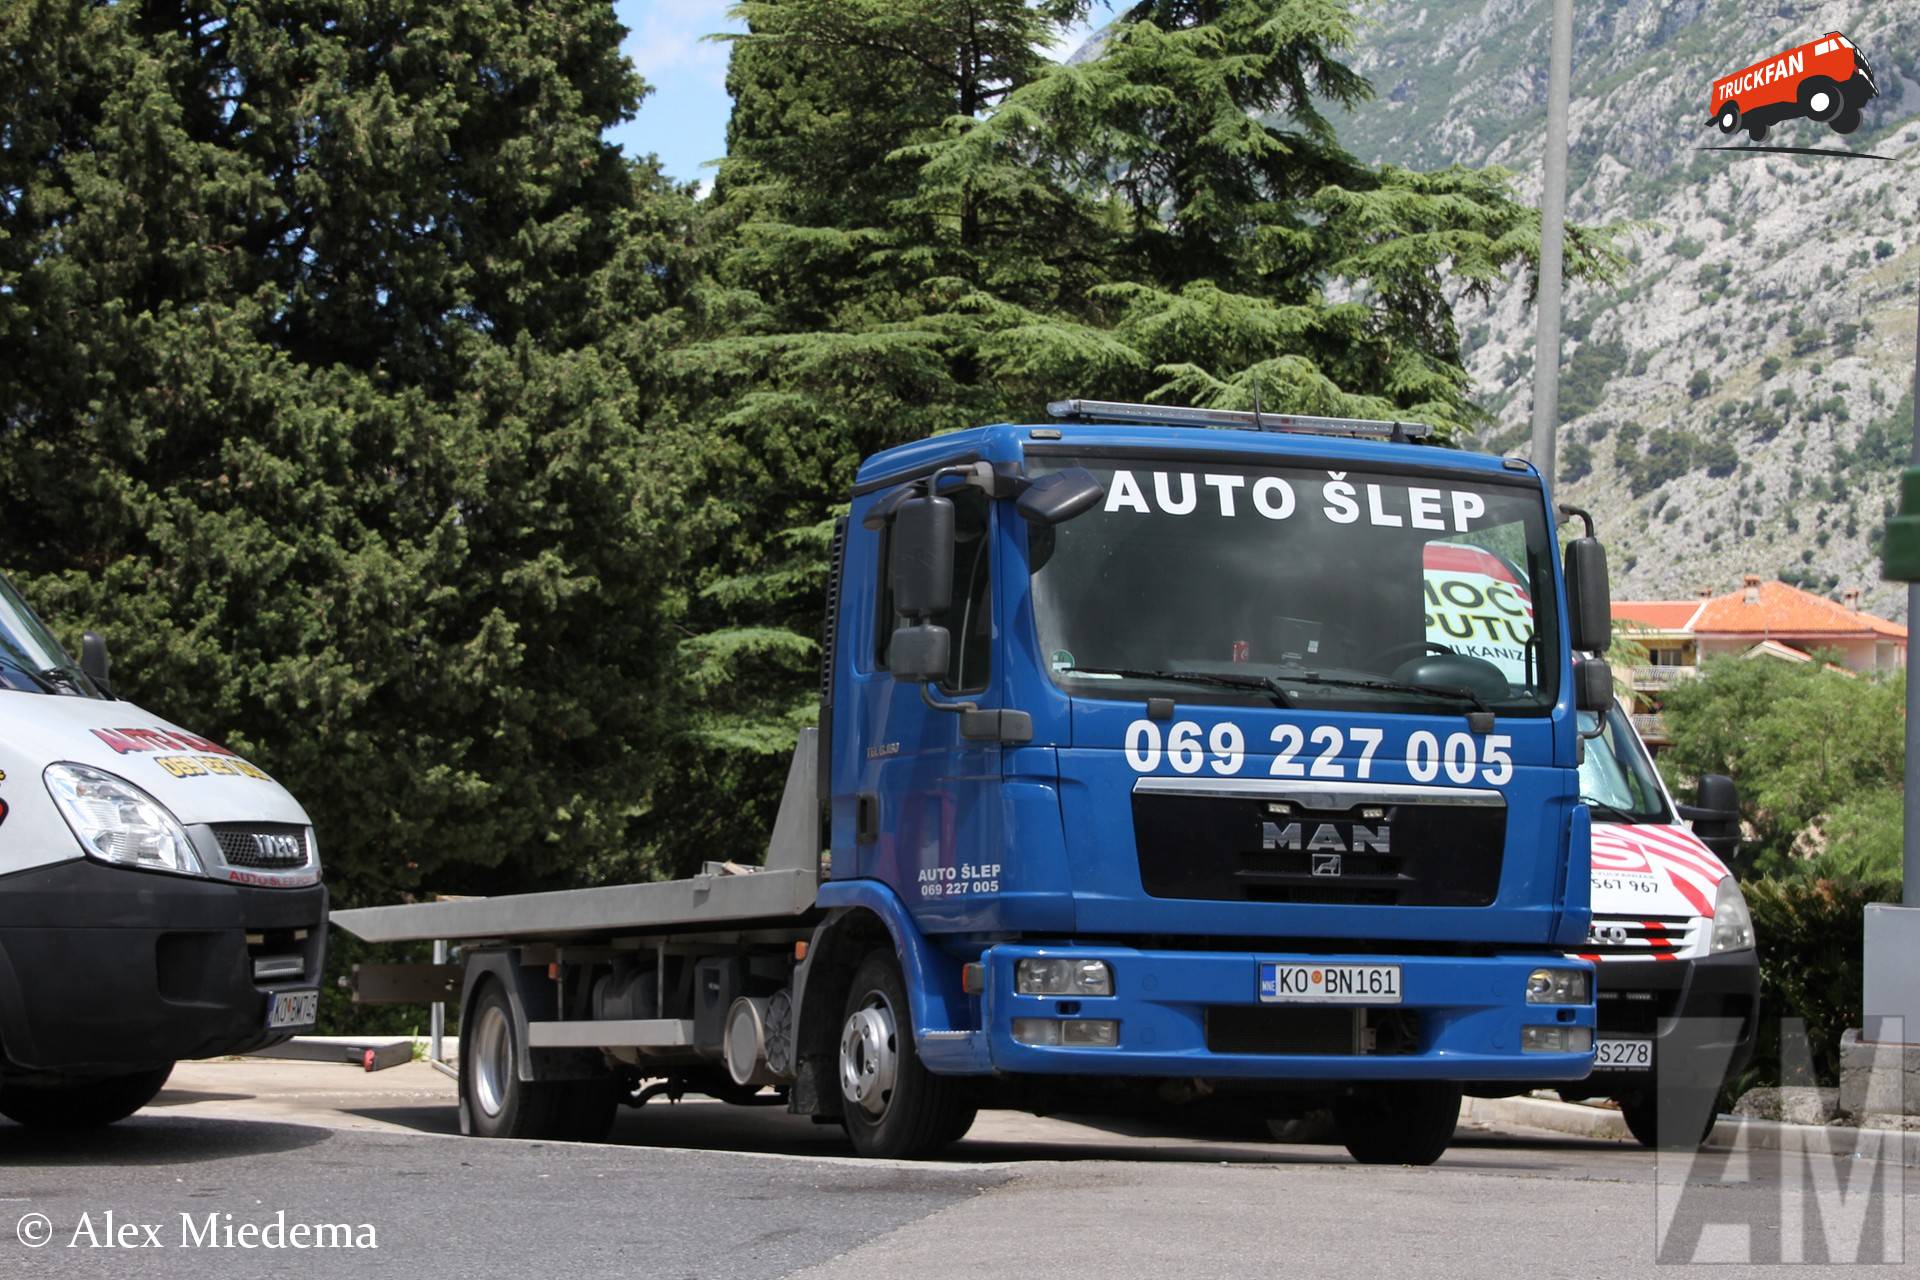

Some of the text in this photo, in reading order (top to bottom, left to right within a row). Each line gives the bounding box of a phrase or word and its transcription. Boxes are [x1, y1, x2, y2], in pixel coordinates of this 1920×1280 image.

[1104, 470, 1485, 533] AUTO ŠLEP
[1125, 718, 1514, 786] 069 227 005
[1262, 821, 1390, 853] MAN
[917, 863, 1001, 882] AUTO ŠLEP
[921, 880, 999, 896] 069 227 005
[1629, 881, 1658, 893] 967
[1279, 968, 1396, 995] KO BN161
